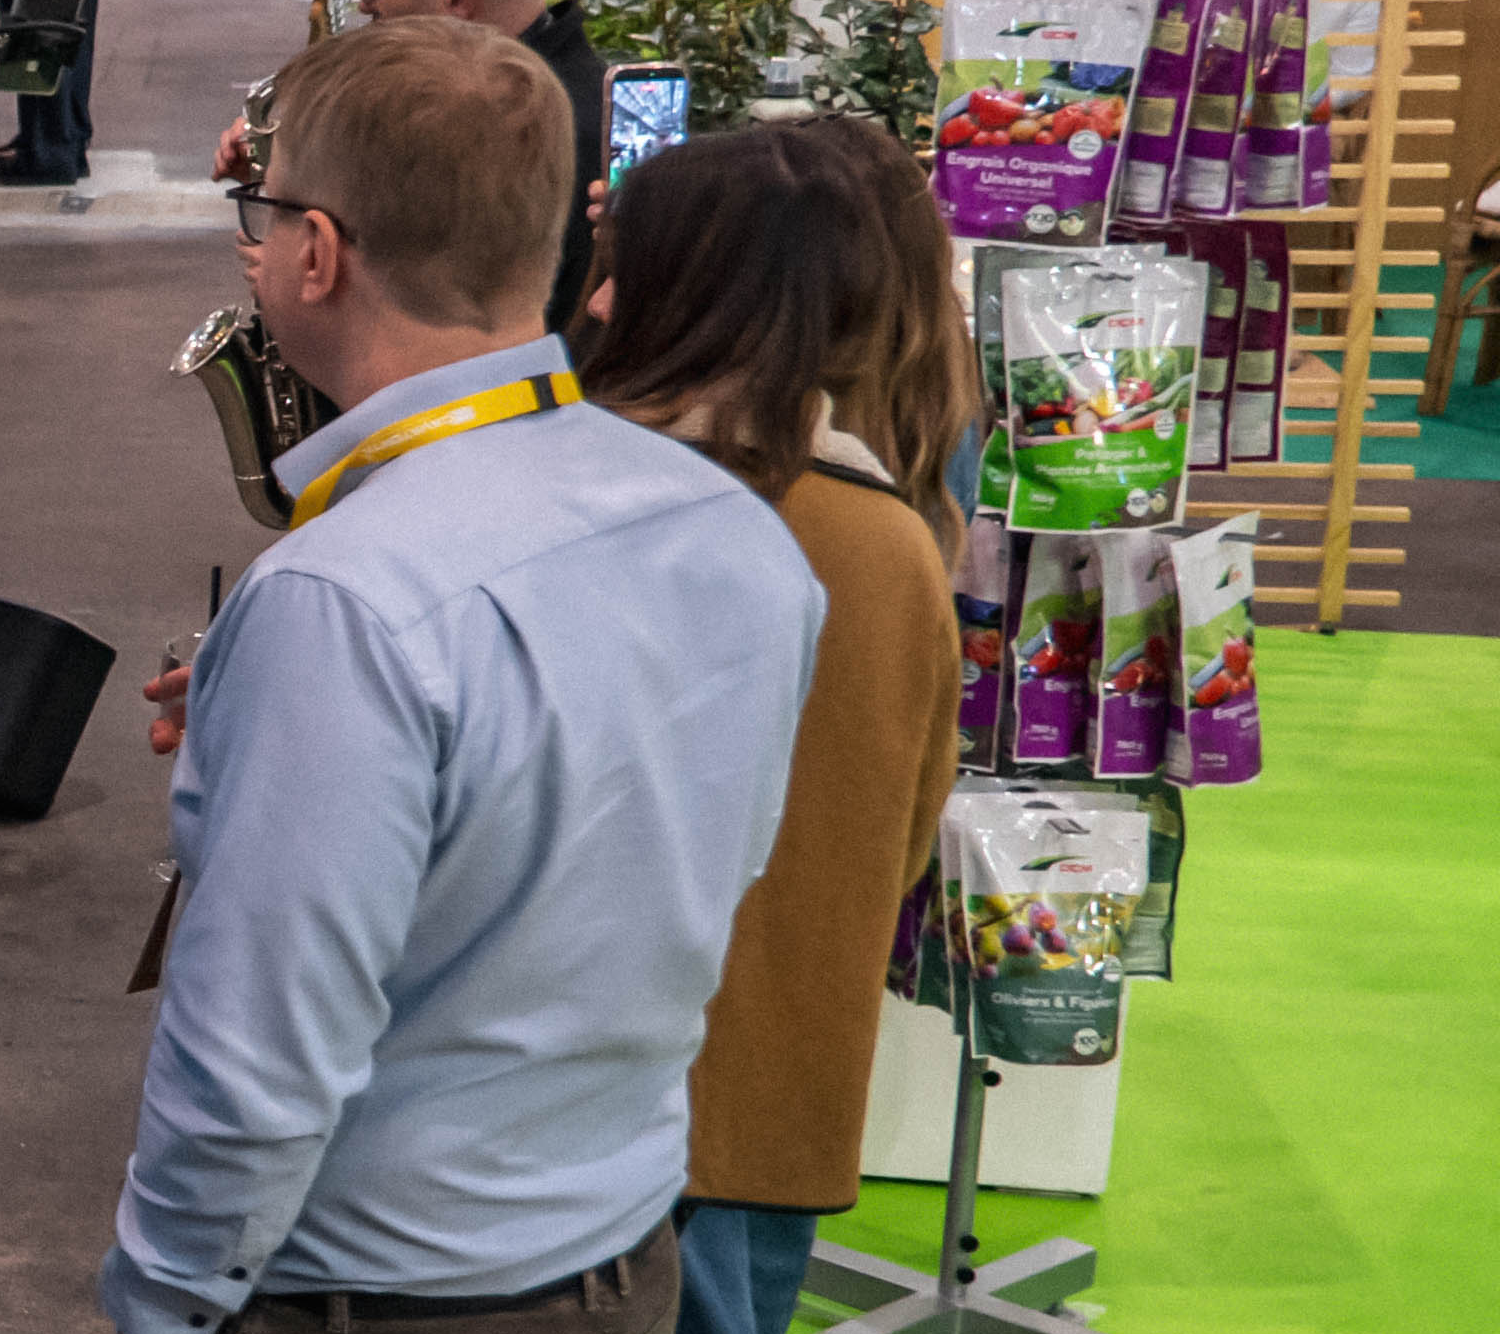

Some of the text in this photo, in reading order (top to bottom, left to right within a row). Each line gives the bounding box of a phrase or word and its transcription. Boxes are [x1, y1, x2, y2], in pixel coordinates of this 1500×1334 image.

[945, 151, 1093, 176] Engrais Organique
[980, 171, 1053, 188] Universel
